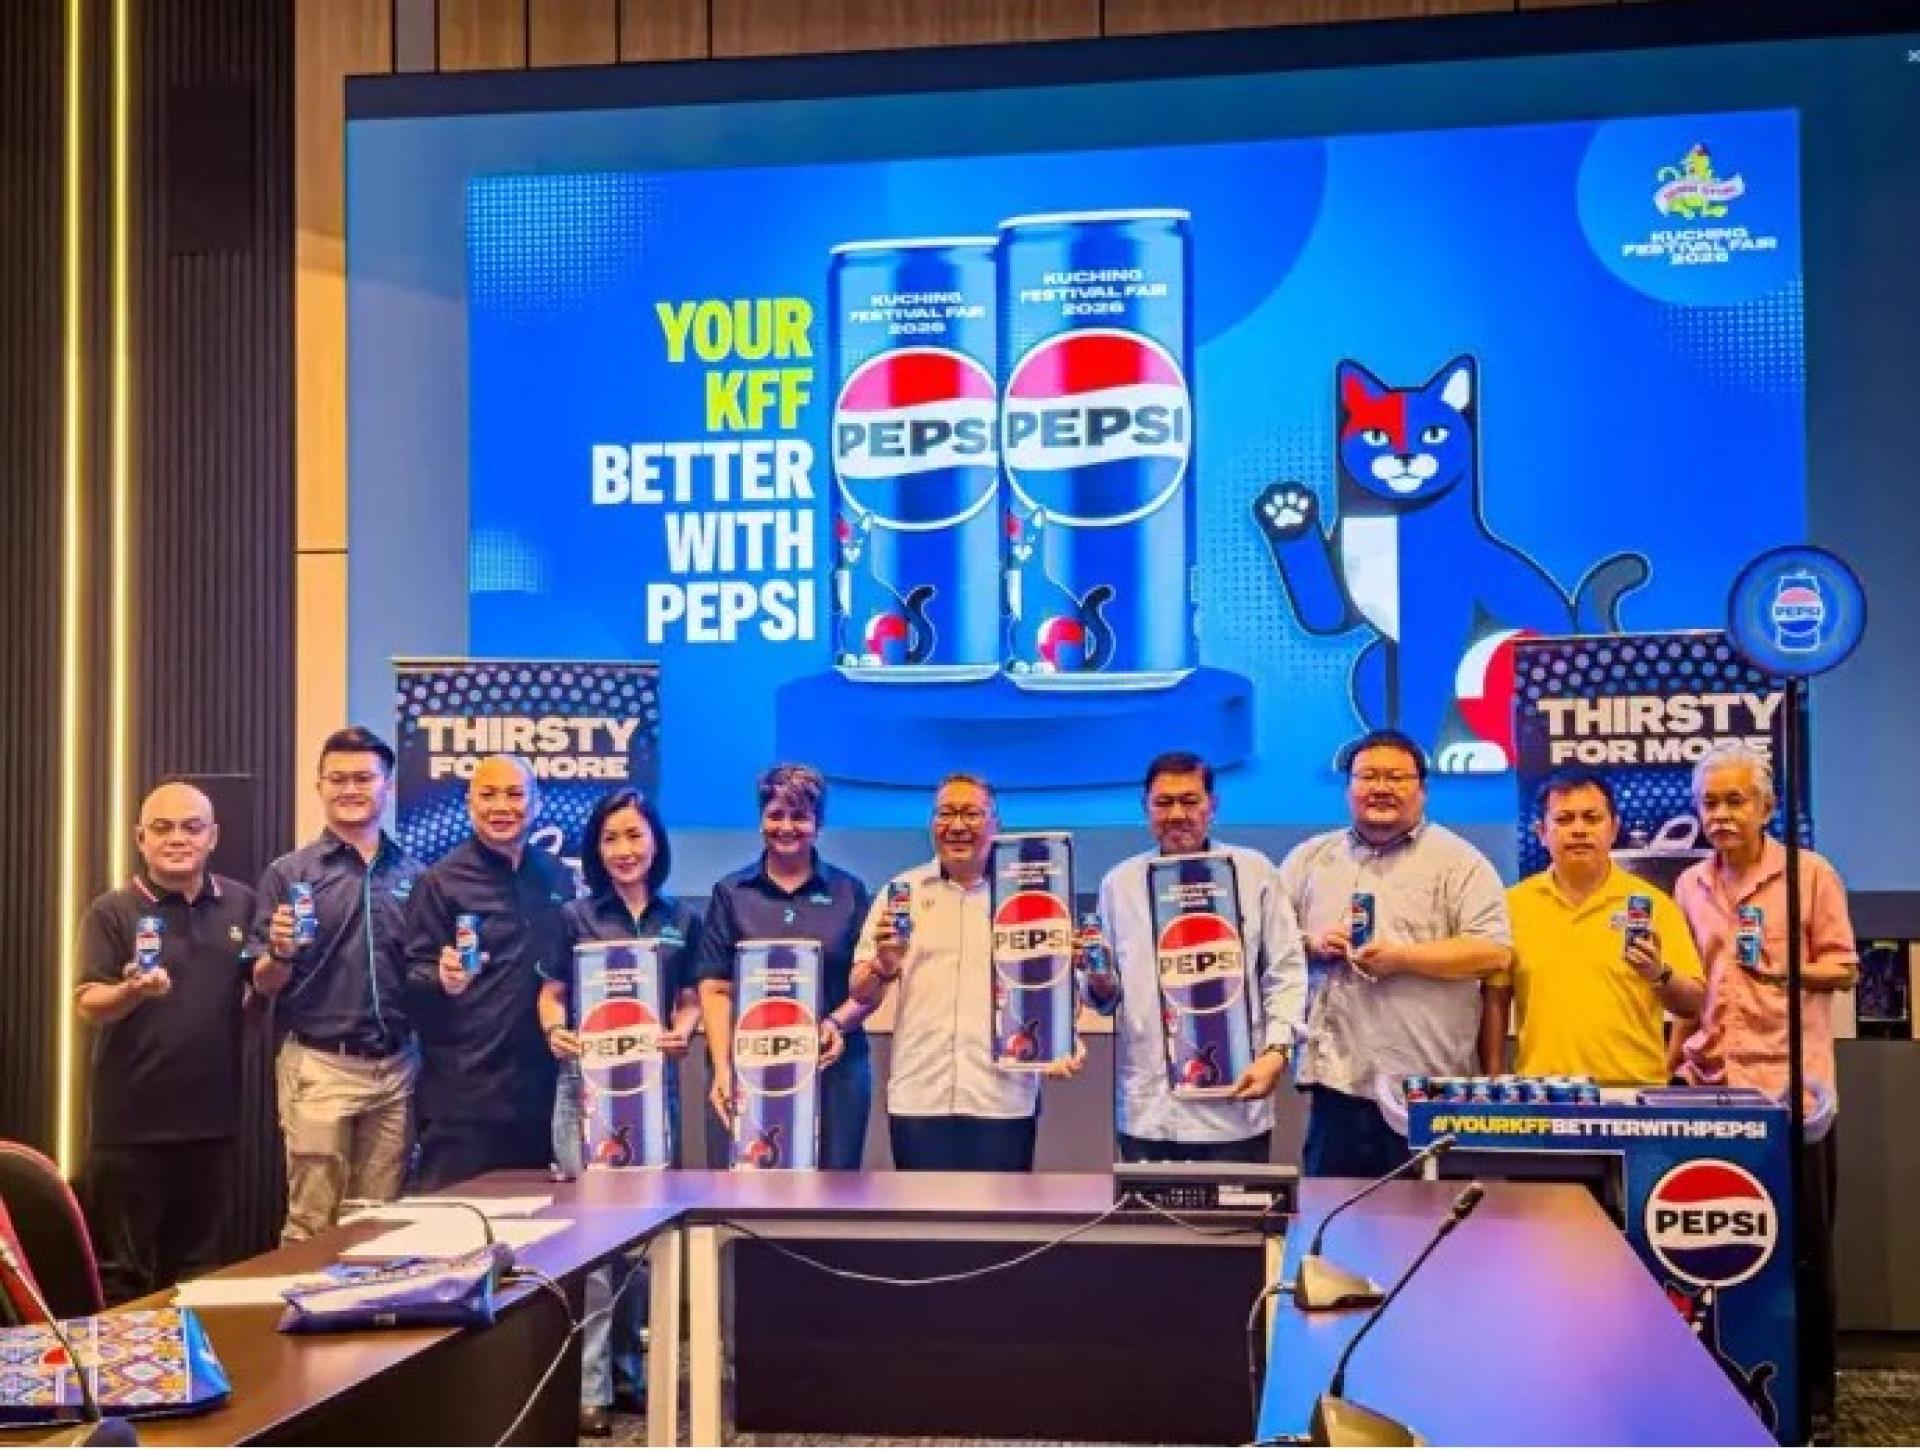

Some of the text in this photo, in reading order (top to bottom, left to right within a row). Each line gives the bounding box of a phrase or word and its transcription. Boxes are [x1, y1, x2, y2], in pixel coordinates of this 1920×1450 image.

[1021, 285, 1122, 303] FESTIVAL
[1043, 269, 1144, 285] KUCHING
[870, 291, 962, 307] KUCHING
[656, 298, 813, 363] YOUR
[705, 369, 813, 432] KFF
[837, 418, 999, 458] PEPSI
[1006, 405, 1184, 449] PEPSI
[592, 439, 814, 504] BETTER
[665, 509, 814, 574] WITH
[646, 580, 815, 644] PEPSI
[417, 717, 641, 752] THIRSTY
[1536, 693, 1785, 736] THIRSTY
[1550, 739, 1639, 766] FOR
[1655, 1209, 1768, 1237] PEPSI
